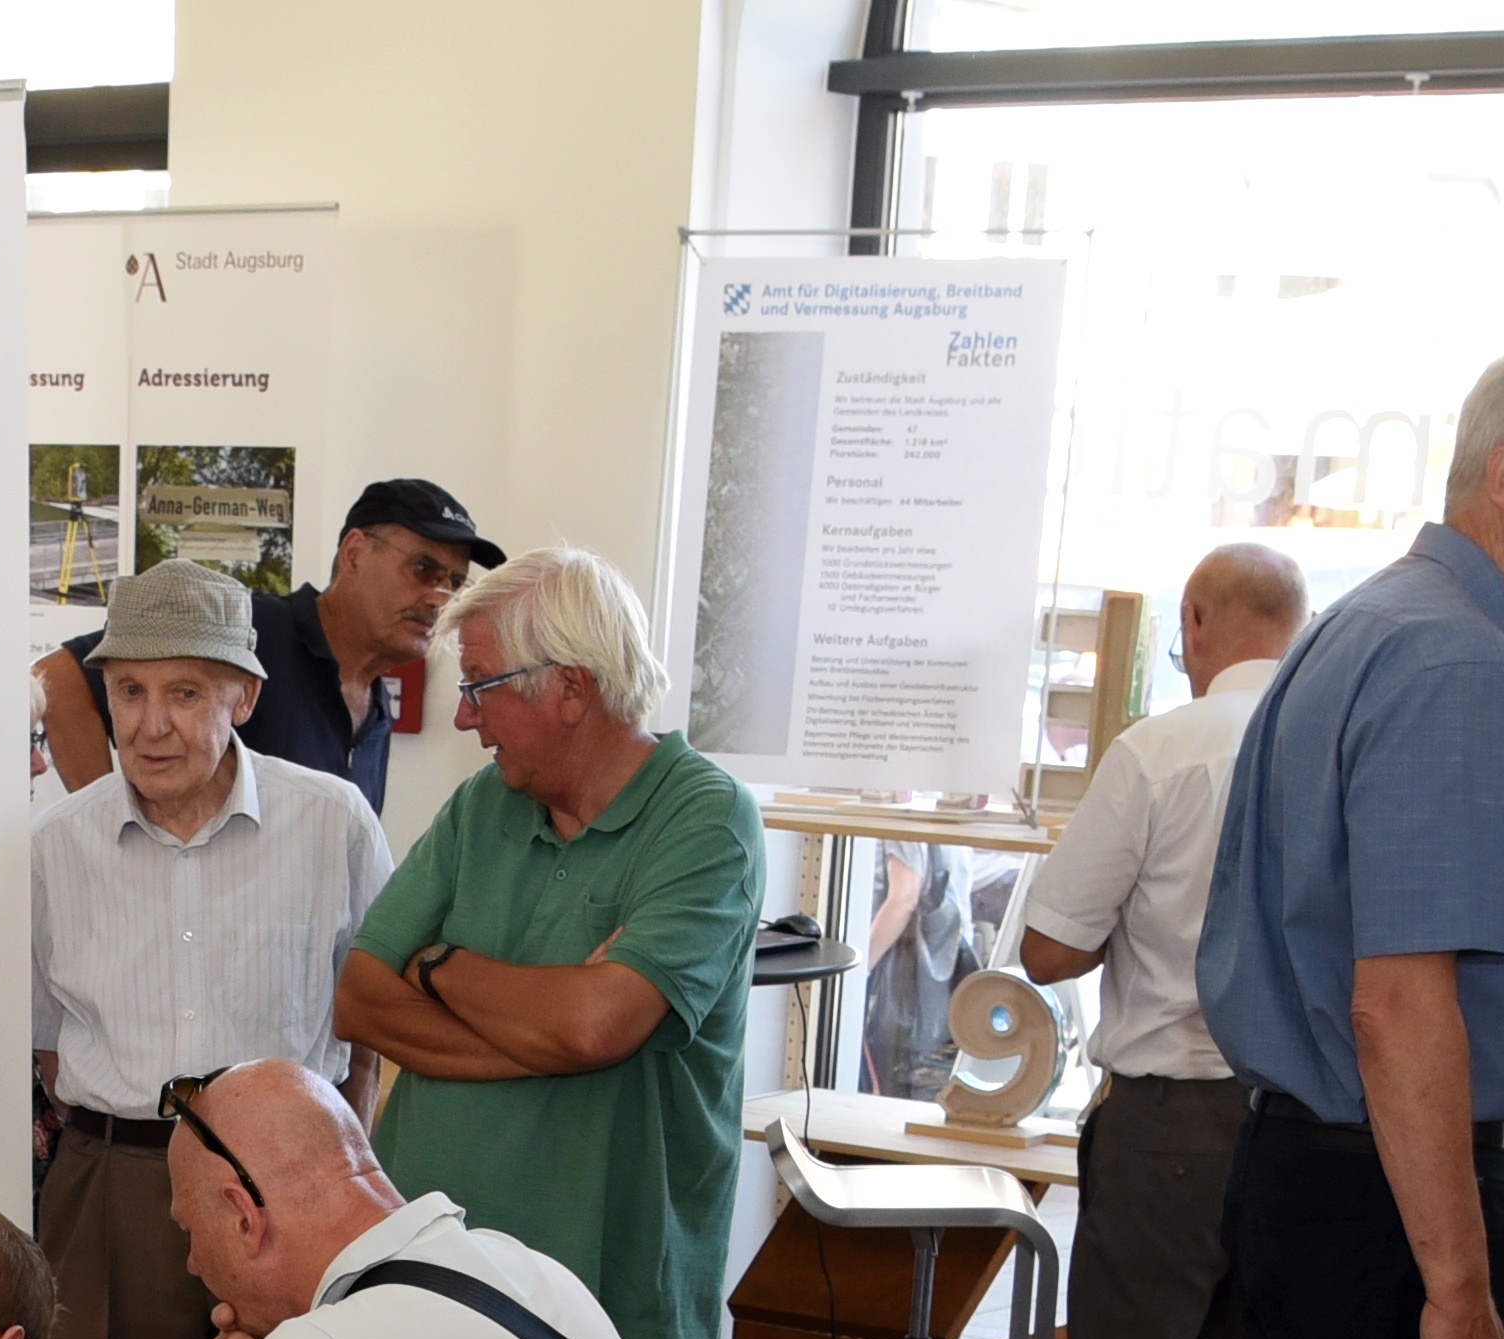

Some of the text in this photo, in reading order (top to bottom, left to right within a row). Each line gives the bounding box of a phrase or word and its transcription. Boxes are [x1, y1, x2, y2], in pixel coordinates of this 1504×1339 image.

[175, 251, 305, 273] Stadt Augsburg
[761, 283, 1024, 302] Amt für Digitalisierung, Breitband
[761, 303, 968, 320] und Vermessung Augsburg
[949, 331, 1018, 349] Zahlen
[946, 347, 1016, 367] Fakten
[137, 368, 271, 393] Adressierung
[836, 371, 926, 386] Zuständigkeit
[826, 476, 883, 488] Personal
[147, 494, 286, 520] Anna-German-Weg
[822, 525, 913, 540] Kernaufgaben
[813, 632, 928, 650] Weitere Aufgaben
